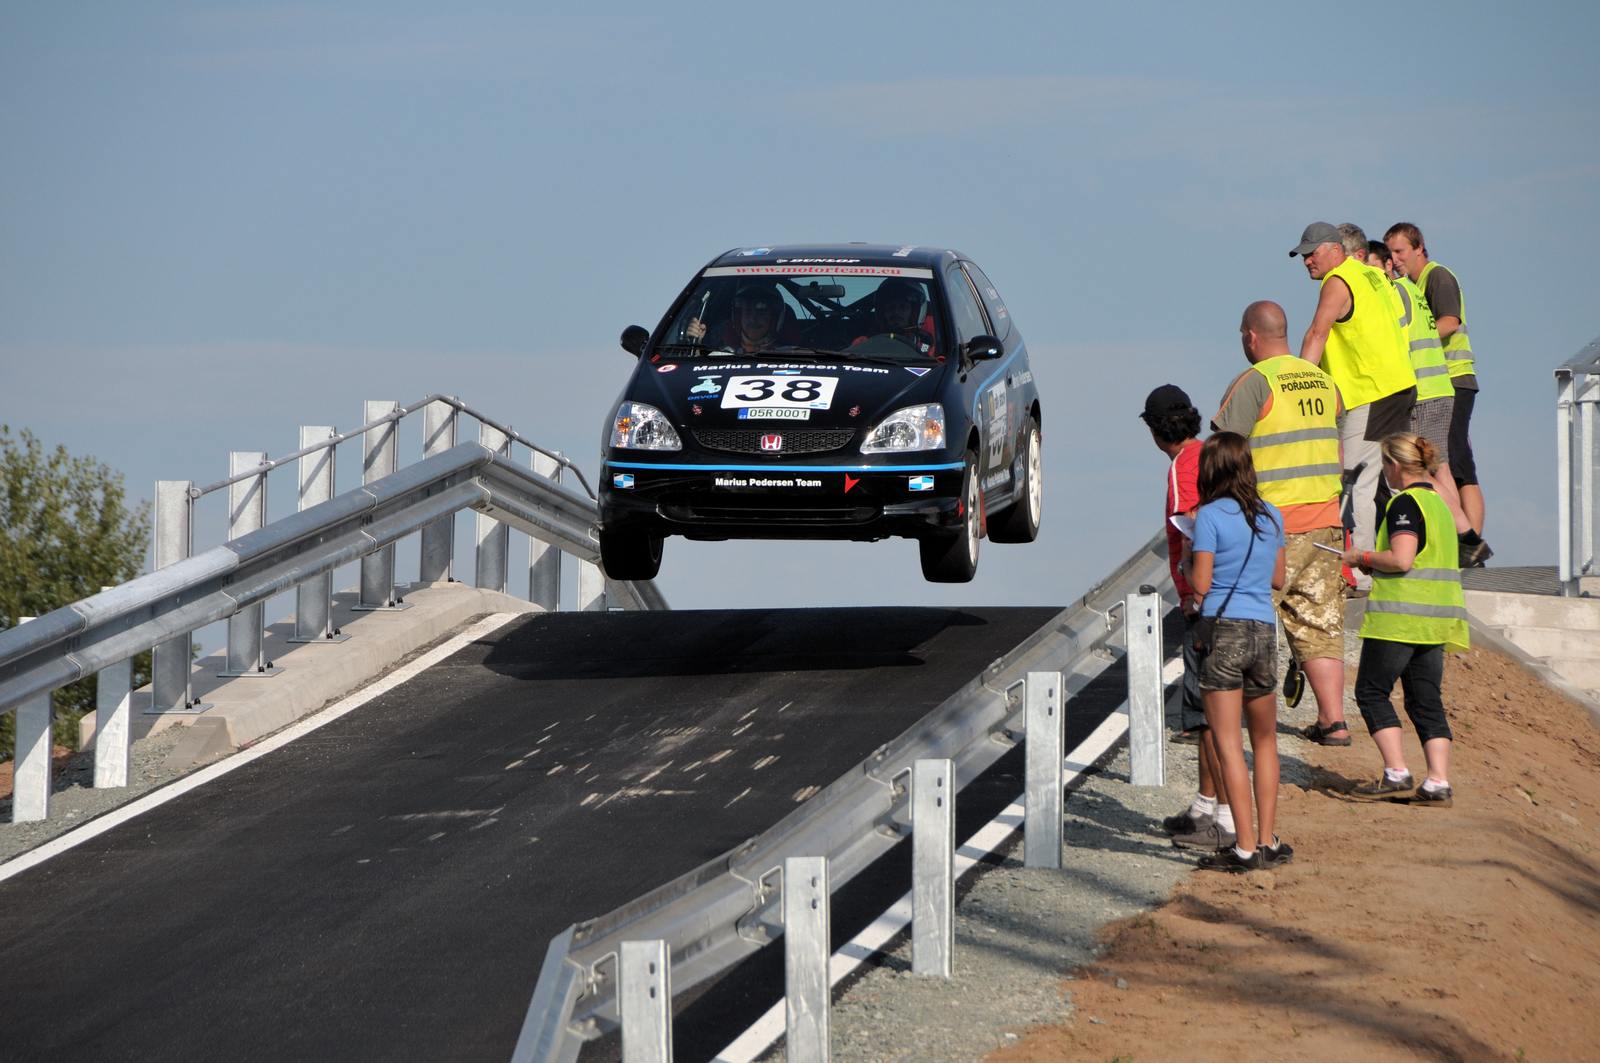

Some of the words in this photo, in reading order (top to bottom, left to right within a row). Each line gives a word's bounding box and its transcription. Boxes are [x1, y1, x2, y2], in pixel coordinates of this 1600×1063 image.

[736, 266, 901, 275] www.motorteam.eu
[692, 364, 751, 372] Marius
[842, 365, 890, 374] Team
[735, 379, 822, 402] 38
[1281, 379, 1329, 392] POŘADATEL
[1298, 398, 1324, 416] 110
[775, 409, 808, 418] 0001
[715, 478, 748, 487] Marius
[749, 478, 794, 487] Pedersen
[795, 478, 822, 487] Team
